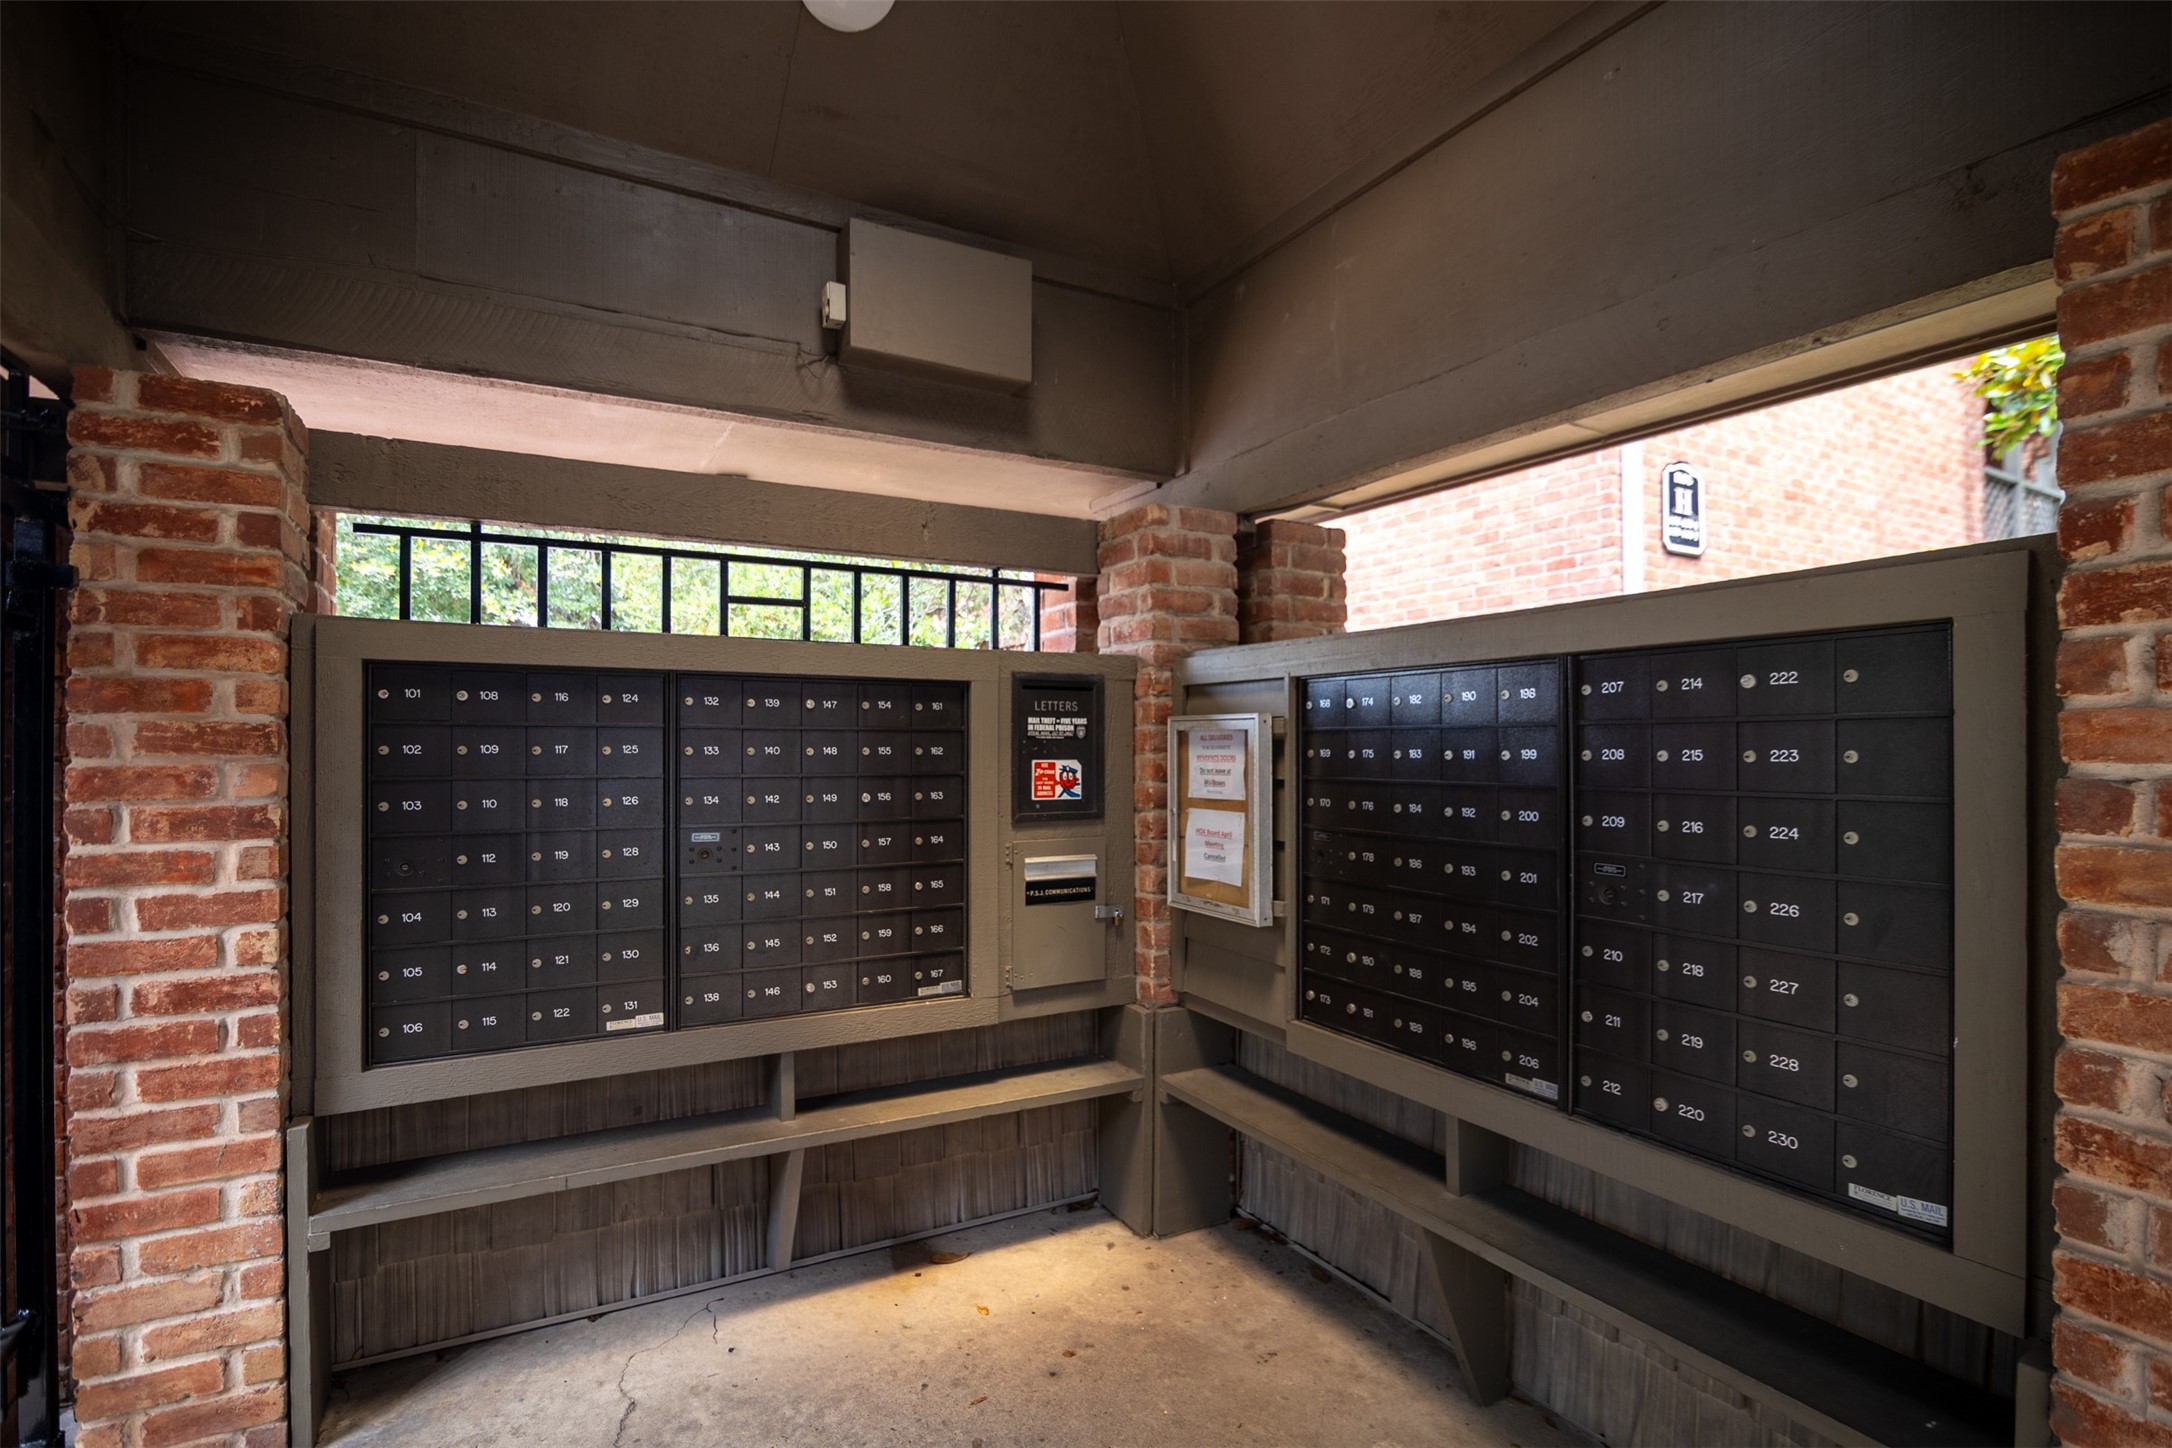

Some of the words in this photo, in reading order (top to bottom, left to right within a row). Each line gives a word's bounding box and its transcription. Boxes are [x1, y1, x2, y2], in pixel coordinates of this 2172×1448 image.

[1769, 670, 1799, 686] 222
[1601, 680, 1625, 694] 207
[1681, 677, 1704, 691] 214
[404, 688, 421, 699] 101
[479, 690, 499, 701] 108
[554, 692, 569, 702] 116
[621, 693, 639, 703] 124
[1461, 690, 1477, 702] 190
[1519, 687, 1537, 700] 198
[703, 696, 720, 706] 132
[764, 698, 781, 708] 139
[822, 700, 838, 709] 147
[877, 700, 892, 710] 154
[1319, 698, 1331, 709] 168
[1361, 696, 1374, 706] 174
[1408, 694, 1422, 705] 182
[931, 701, 943, 711] 161
[1034, 700, 1079, 712] LETTERS
[1027, 716, 1040, 724] MAIL
[402, 744, 422, 755] 102
[479, 744, 500, 755] 109
[554, 744, 569, 755] 117
[622, 744, 639, 754] 125
[703, 745, 720, 756] 133
[764, 746, 781, 755] 140
[822, 746, 838, 756] 148
[877, 746, 892, 756] 155
[930, 746, 944, 756] 162
[1319, 748, 1331, 758] 169
[1362, 748, 1375, 759] 175
[1408, 748, 1423, 759] 183
[1462, 749, 1476, 760] 191
[1520, 748, 1538, 760] 199
[1601, 748, 1625, 761] 208
[1681, 749, 1704, 762] 215
[1769, 749, 1800, 763] 223
[621, 795, 639, 806] 126
[703, 795, 720, 805] 134
[764, 794, 780, 804] 142
[822, 793, 838, 803] 149
[877, 792, 892, 801] 156
[929, 791, 944, 800] 163
[401, 800, 423, 811] 103
[481, 798, 498, 809] 110
[554, 797, 569, 807] 118
[1319, 797, 1332, 808] 170
[1361, 800, 1375, 811] 176
[1408, 803, 1423, 814] 184
[1461, 807, 1476, 818] 192
[1518, 810, 1540, 822] 200
[1601, 815, 1626, 828] 209
[1681, 820, 1704, 834] 216
[1221, 831, 1232, 839] April
[1769, 826, 1800, 840] 224
[822, 840, 838, 850] 150
[877, 837, 892, 847] 157
[930, 835, 944, 844] 164
[622, 846, 640, 857] 128
[764, 842, 781, 852] 143
[481, 853, 497, 863] 112
[554, 850, 569, 860] 119
[1362, 851, 1375, 863] 178
[1408, 858, 1423, 870] 186
[1460, 865, 1477, 877] 193
[1519, 871, 1538, 884] 201
[877, 883, 892, 892] 158
[930, 879, 944, 889] 165
[764, 890, 781, 900] 144
[824, 887, 836, 897] 151
[1045, 887, 1091, 896] COMMUNICATIONS
[622, 897, 640, 908] 129
[703, 894, 720, 904] 135
[1320, 895, 1331, 906] 171
[1682, 891, 1705, 905] 217
[481, 907, 497, 918] 113
[552, 902, 571, 913] 120
[1362, 903, 1375, 915] 179
[1769, 902, 1800, 918] 226
[401, 912, 422, 923] 104
[1408, 912, 1423, 924] 187
[877, 928, 893, 938] 159
[929, 924, 944, 934] 166
[1461, 922, 1477, 934] 194
[764, 938, 781, 948] 145
[822, 933, 838, 943] 152
[1518, 933, 1539, 947] 202
[703, 942, 720, 953] 136
[1319, 944, 1332, 956] 172
[554, 954, 569, 965] 121
[622, 949, 640, 960] 130
[1603, 948, 1624, 963] 210
[481, 961, 497, 972] 114
[1361, 955, 1375, 967] 180
[402, 966, 423, 978] 105
[930, 968, 944, 978] 167
[1408, 967, 1423, 980] 188
[1682, 962, 1704, 978] 218
[822, 979, 838, 990] 153
[877, 974, 892, 984] 160
[764, 986, 781, 996] 146
[1461, 980, 1477, 993] 195
[1769, 978, 1800, 995] 227
[703, 992, 720, 1003] 138
[1319, 993, 1332, 1005] 173
[1518, 993, 1540, 1008] 204
[623, 1000, 638, 1011] 131
[553, 1007, 571, 1018] 122
[1362, 1007, 1374, 1019] 181
[482, 1015, 497, 1027] 115
[1604, 1014, 1621, 1028] 211
[402, 1022, 424, 1034] 106
[1408, 1021, 1423, 1034] 189
[1461, 1037, 1477, 1051] 196
[1681, 1033, 1704, 1049] 219
[1518, 1054, 1540, 1070] 206
[1769, 1054, 1800, 1072] 228
[1602, 1079, 1622, 1096] 212
[1678, 1103, 1705, 1122] 220
[1768, 1130, 1799, 1150] 230
[1854, 1185, 1892, 1201] FLORENCE
[1900, 1198, 1918, 1210] U.S.
[1921, 1203, 1944, 1216] MAIL
